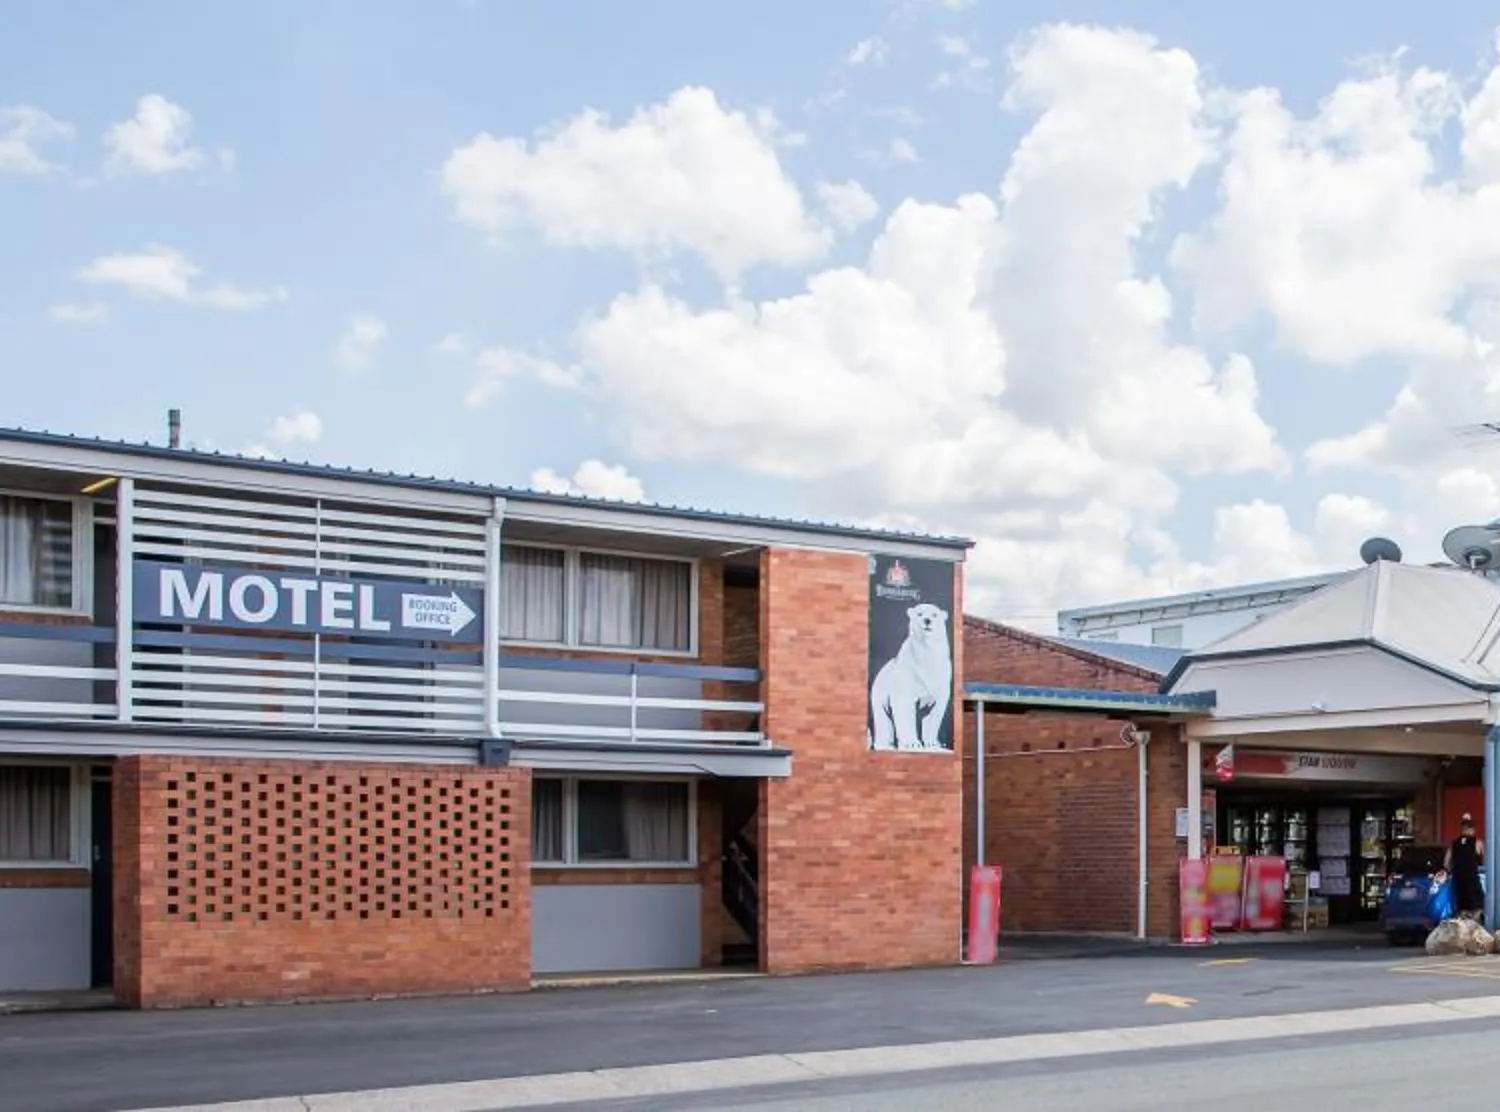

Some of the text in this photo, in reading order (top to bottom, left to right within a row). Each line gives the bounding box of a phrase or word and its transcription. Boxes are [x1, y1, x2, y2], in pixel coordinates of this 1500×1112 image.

[159, 569, 391, 631] MOTEL
[409, 599, 457, 612] BOOKING
[415, 612, 451, 625] OFFICE
